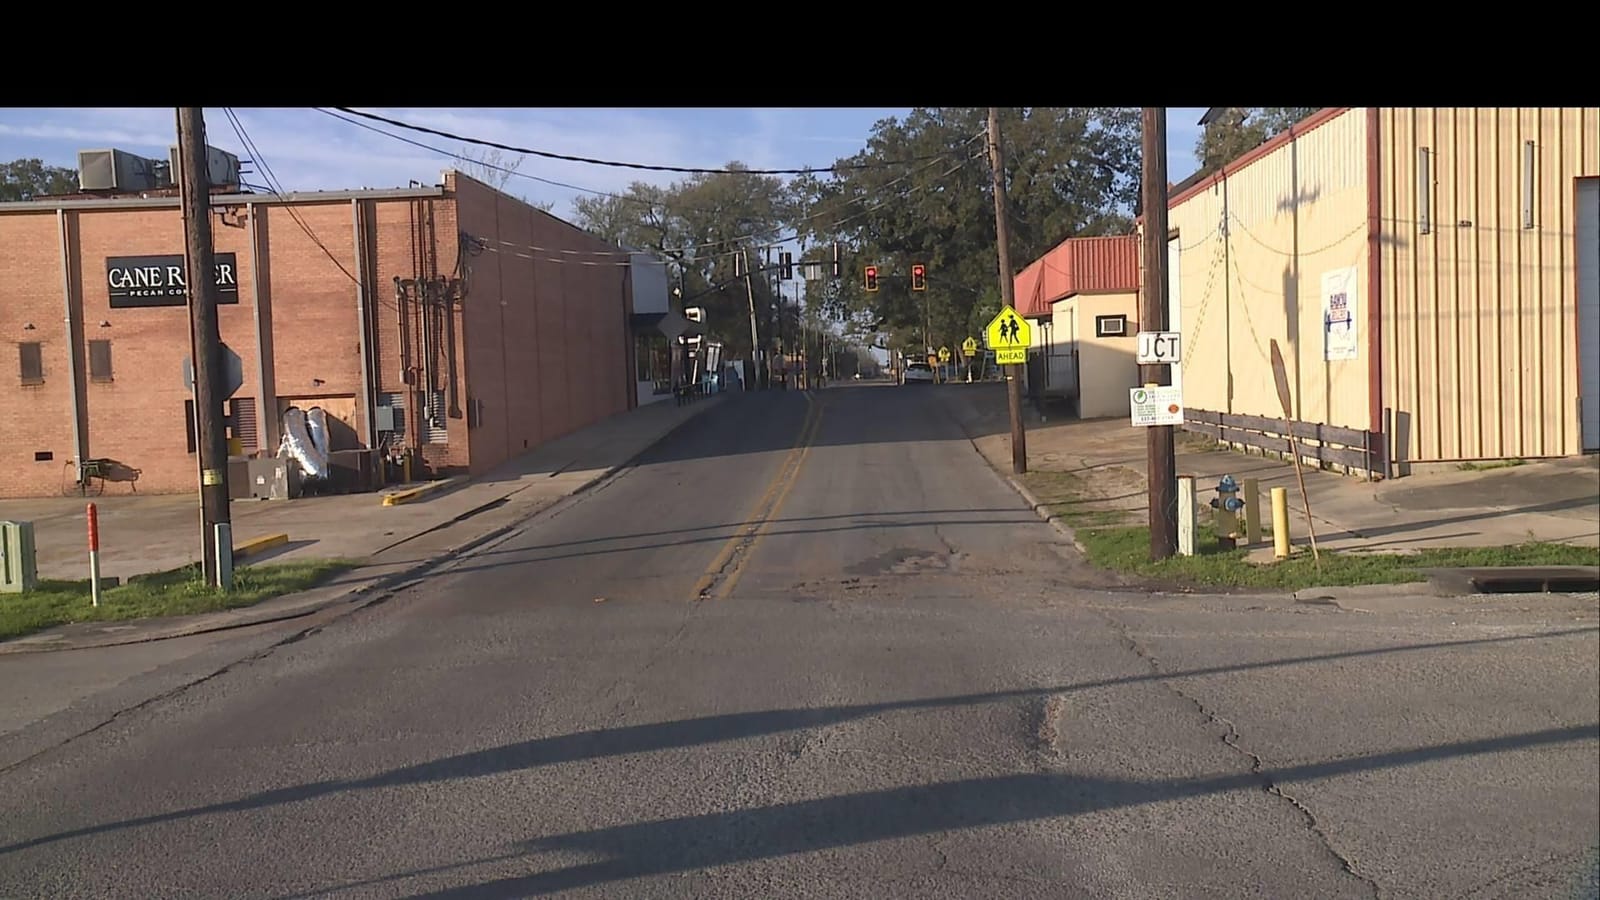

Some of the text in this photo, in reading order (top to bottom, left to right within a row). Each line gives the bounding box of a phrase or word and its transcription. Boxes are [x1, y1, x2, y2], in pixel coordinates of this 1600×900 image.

[109, 266, 162, 288] CANE
[129, 289, 163, 297] PECAN
[1141, 337, 1178, 358] JCT
[998, 352, 1024, 360] AHEAD
